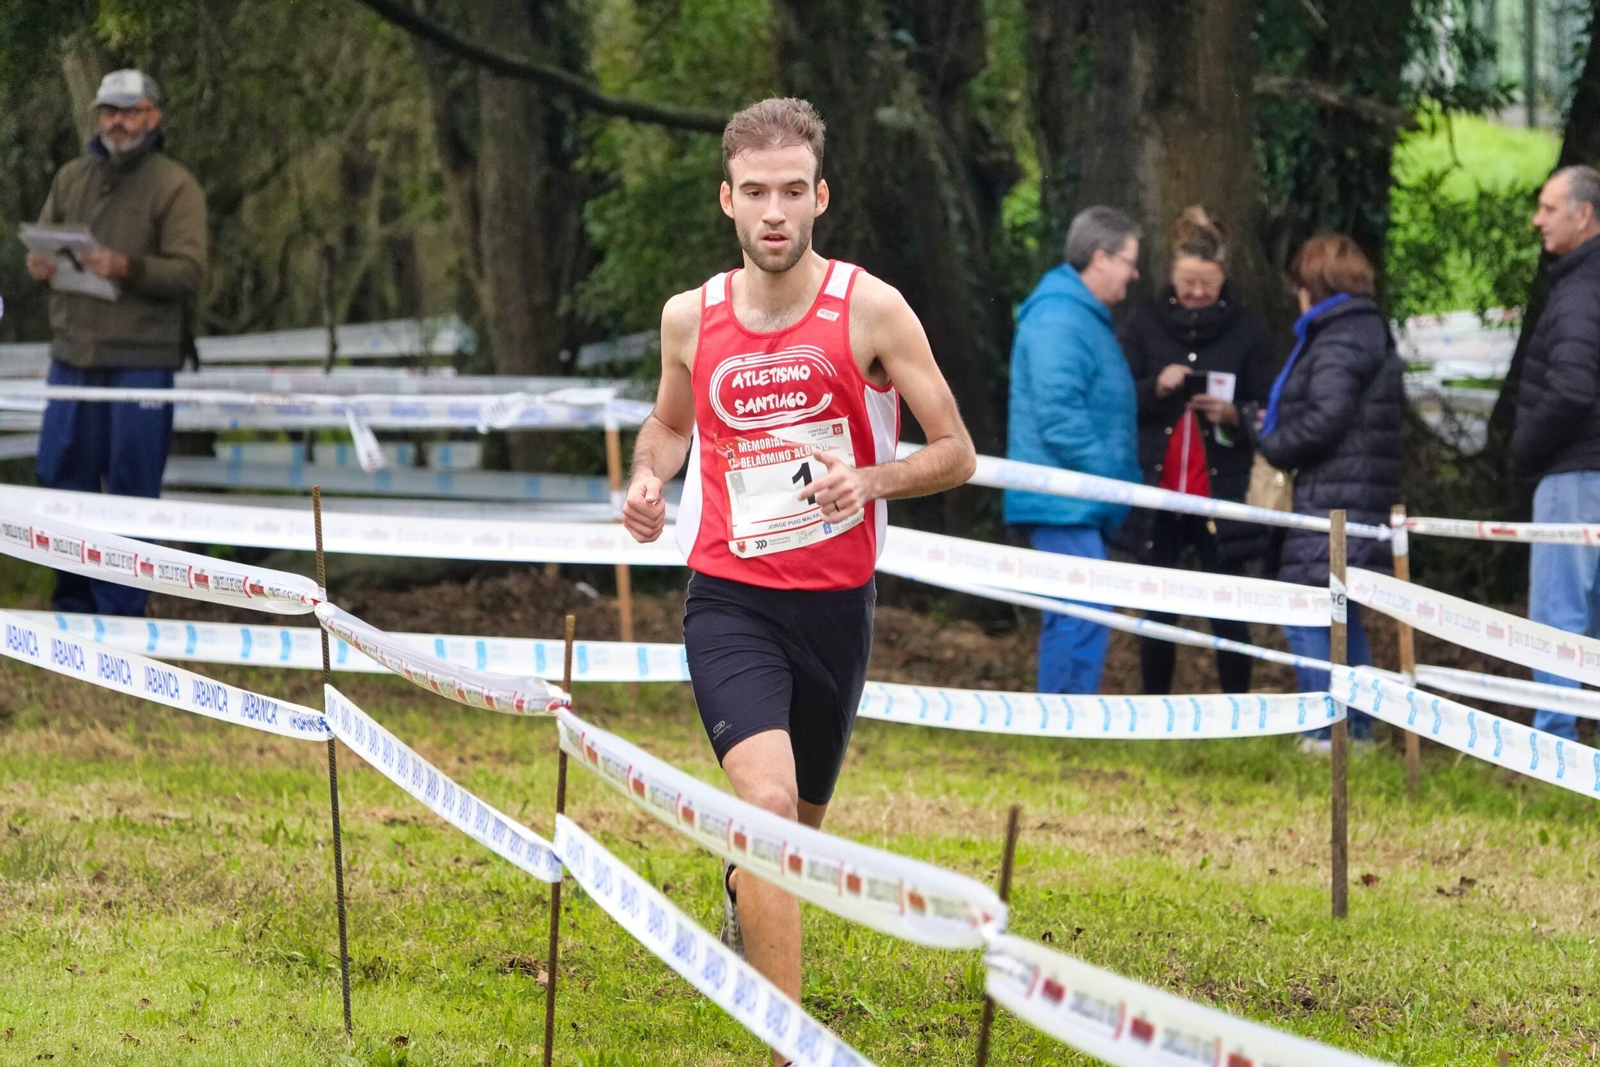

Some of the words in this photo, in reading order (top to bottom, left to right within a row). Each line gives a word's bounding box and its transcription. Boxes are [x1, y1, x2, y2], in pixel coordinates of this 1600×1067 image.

[732, 364, 811, 388] ATLETISMO
[734, 392, 808, 415] SANTIAGO
[738, 438, 785, 453] MEMORIAL
[740, 450, 791, 468] BELARMINO
[794, 441, 829, 459] ALONSO
[768, 520, 786, 530] JORGE
[787, 518, 802, 526] PUIG
[6, 624, 39, 658] ABANCA
[51, 638, 86, 672] ABANCA
[97, 652, 132, 686] ABANCA
[144, 666, 180, 700] ABANCA
[192, 679, 228, 713] ABANCA
[240, 692, 277, 725] ABANCA
